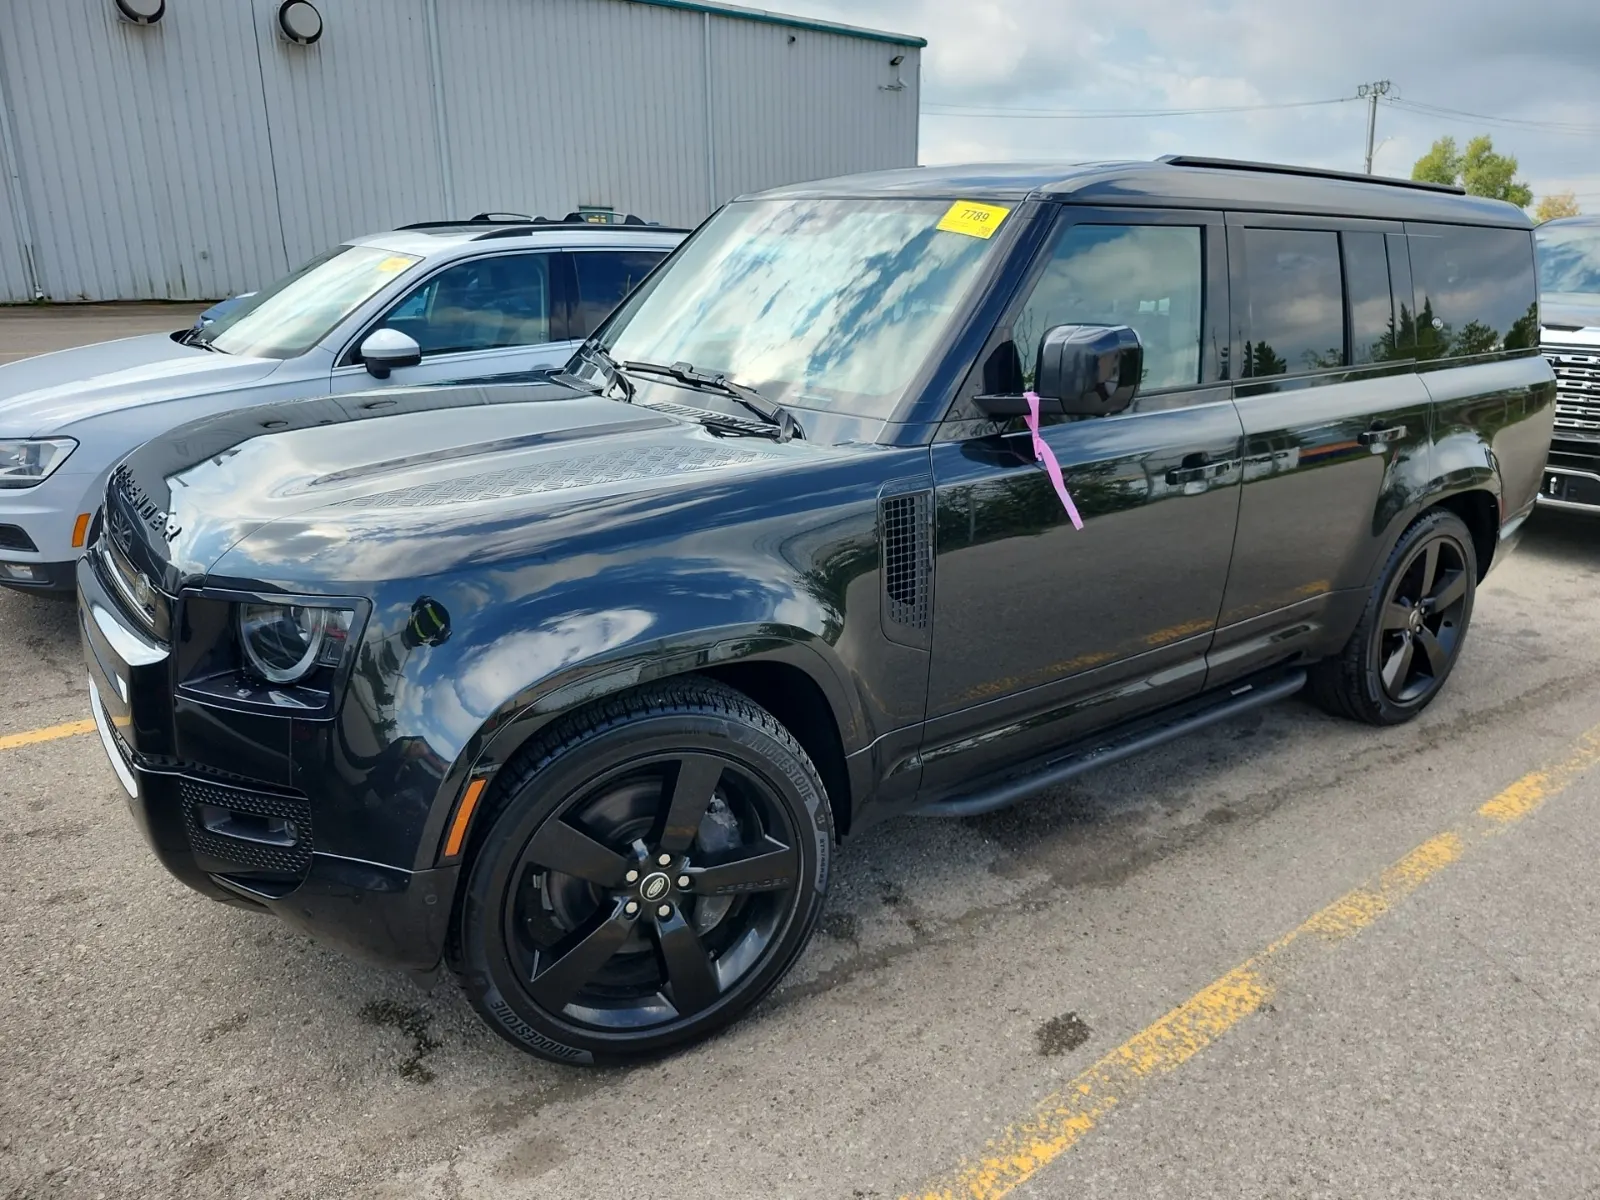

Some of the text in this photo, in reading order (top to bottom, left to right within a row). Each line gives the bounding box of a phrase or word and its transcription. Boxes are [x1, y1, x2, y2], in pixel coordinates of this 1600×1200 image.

[960, 209, 990, 222] 7789
[112, 463, 183, 543] DEFENDER
[716, 877, 790, 894] DEFENDER
[489, 1000, 582, 1061] BRIDGESTONE
